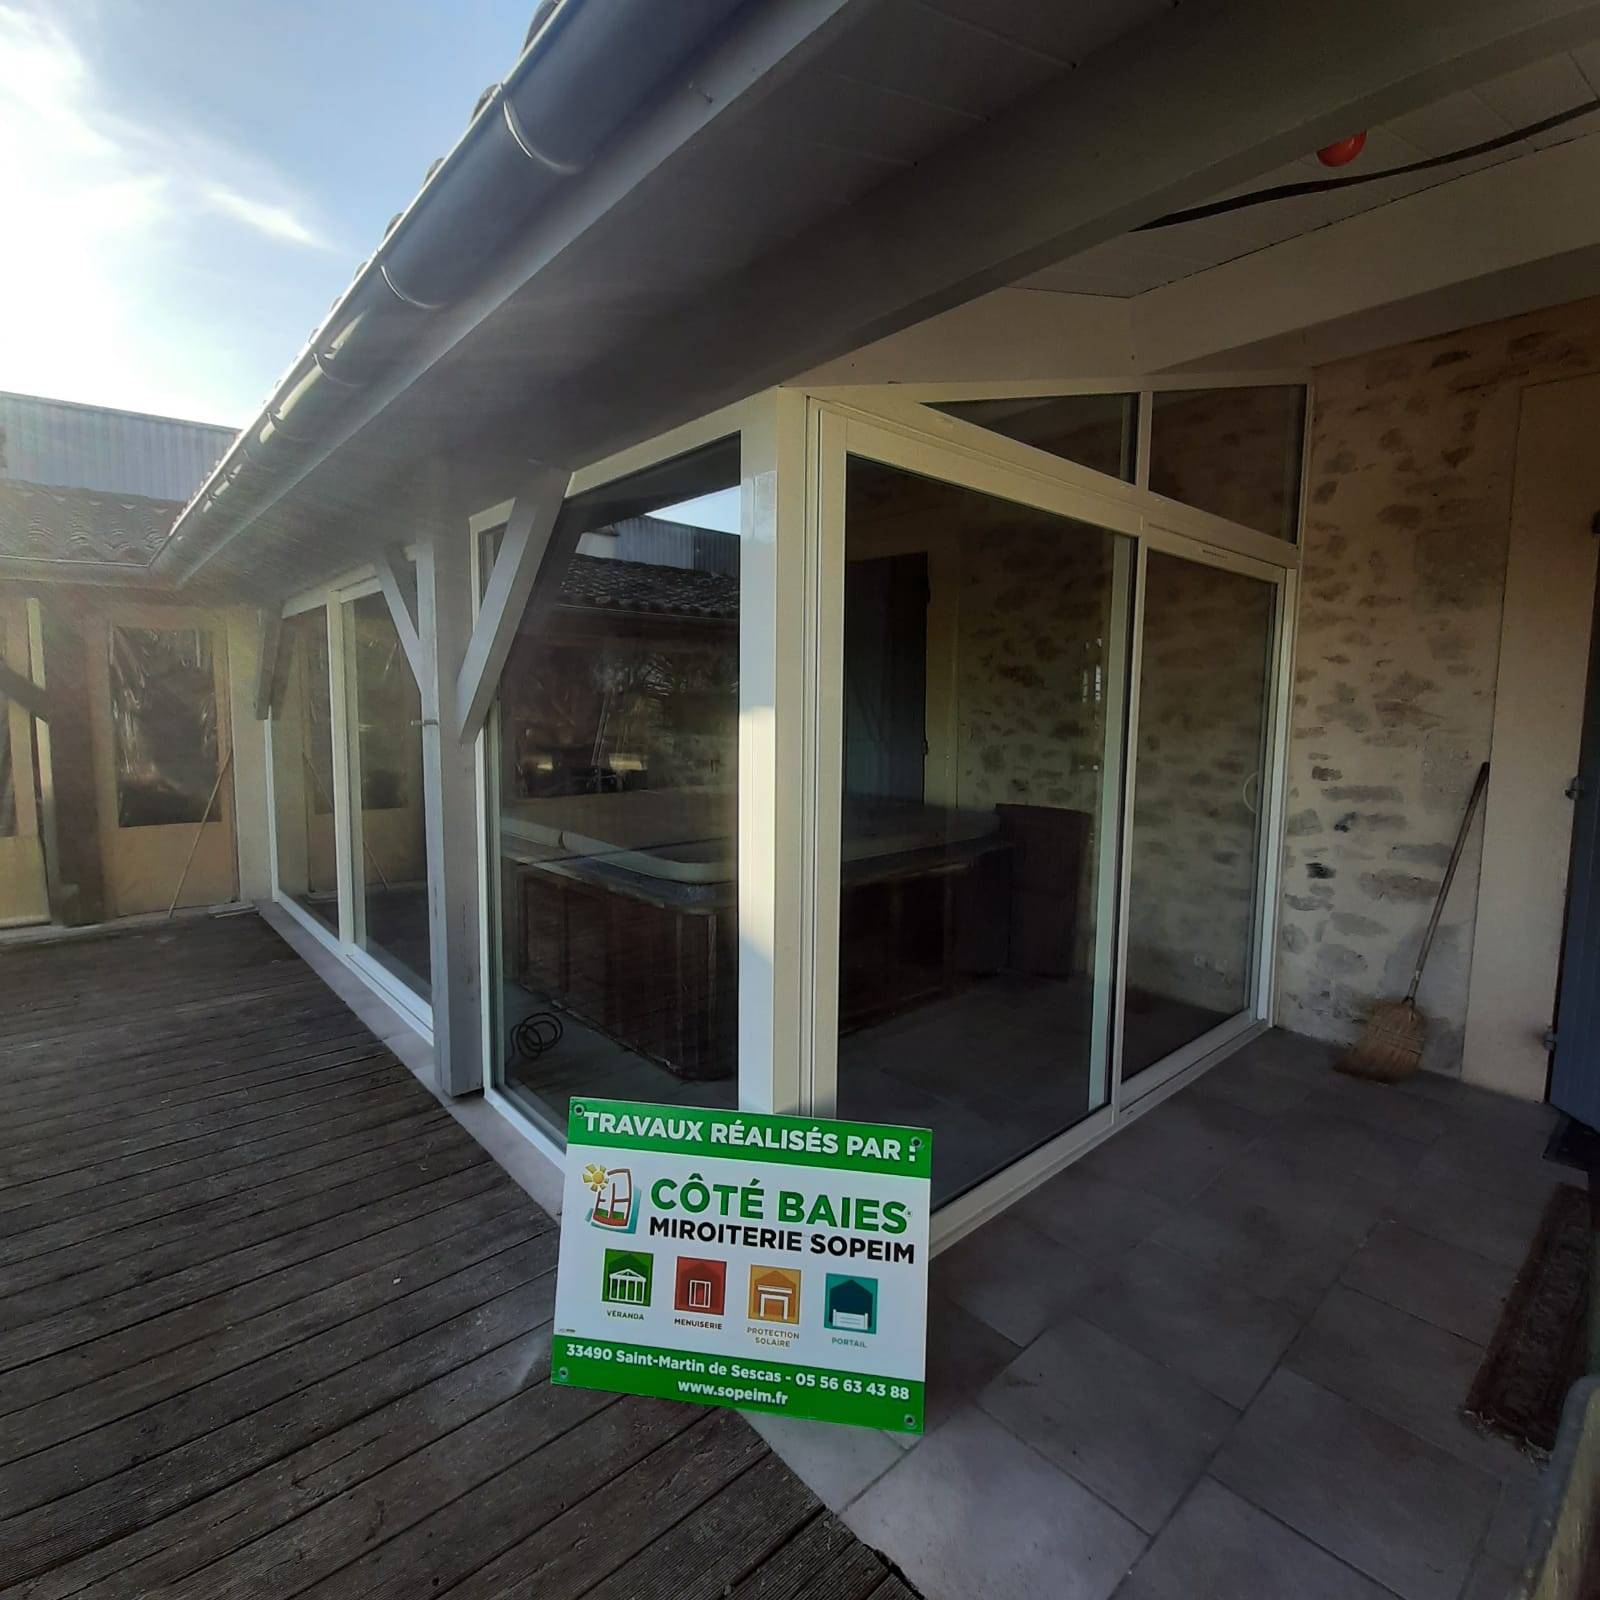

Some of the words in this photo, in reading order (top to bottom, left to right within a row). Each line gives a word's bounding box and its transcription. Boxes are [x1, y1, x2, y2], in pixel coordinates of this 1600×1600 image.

[583, 1111, 704, 1143] TRAVAUX
[710, 1122, 839, 1155] RÉALISÉS
[846, 1136, 902, 1161] PAR
[650, 1172, 766, 1220] CÔTÉ
[777, 1190, 908, 1235] BAIES
[649, 1217, 802, 1252] MIROITERIE
[809, 1233, 915, 1265] SOPEIM
[673, 1317, 723, 1331] MENUISERIE
[746, 1327, 801, 1340] PROTECTION
[754, 1337, 792, 1348] SOLAIRE
[831, 1337, 868, 1349] PORTAIL
[566, 1344, 613, 1361] 33490
[615, 1350, 705, 1373] Saint-Martin
[708, 1361, 728, 1376] de
[731, 1364, 782, 1384] Sescas
[795, 1373, 816, 1387] 05
[819, 1377, 839, 1391] 56
[843, 1380, 863, 1394] 63
[866, 1383, 887, 1397] 43
[890, 1386, 910, 1400] 88
[678, 1379, 788, 1405] www.sopeim.fr
